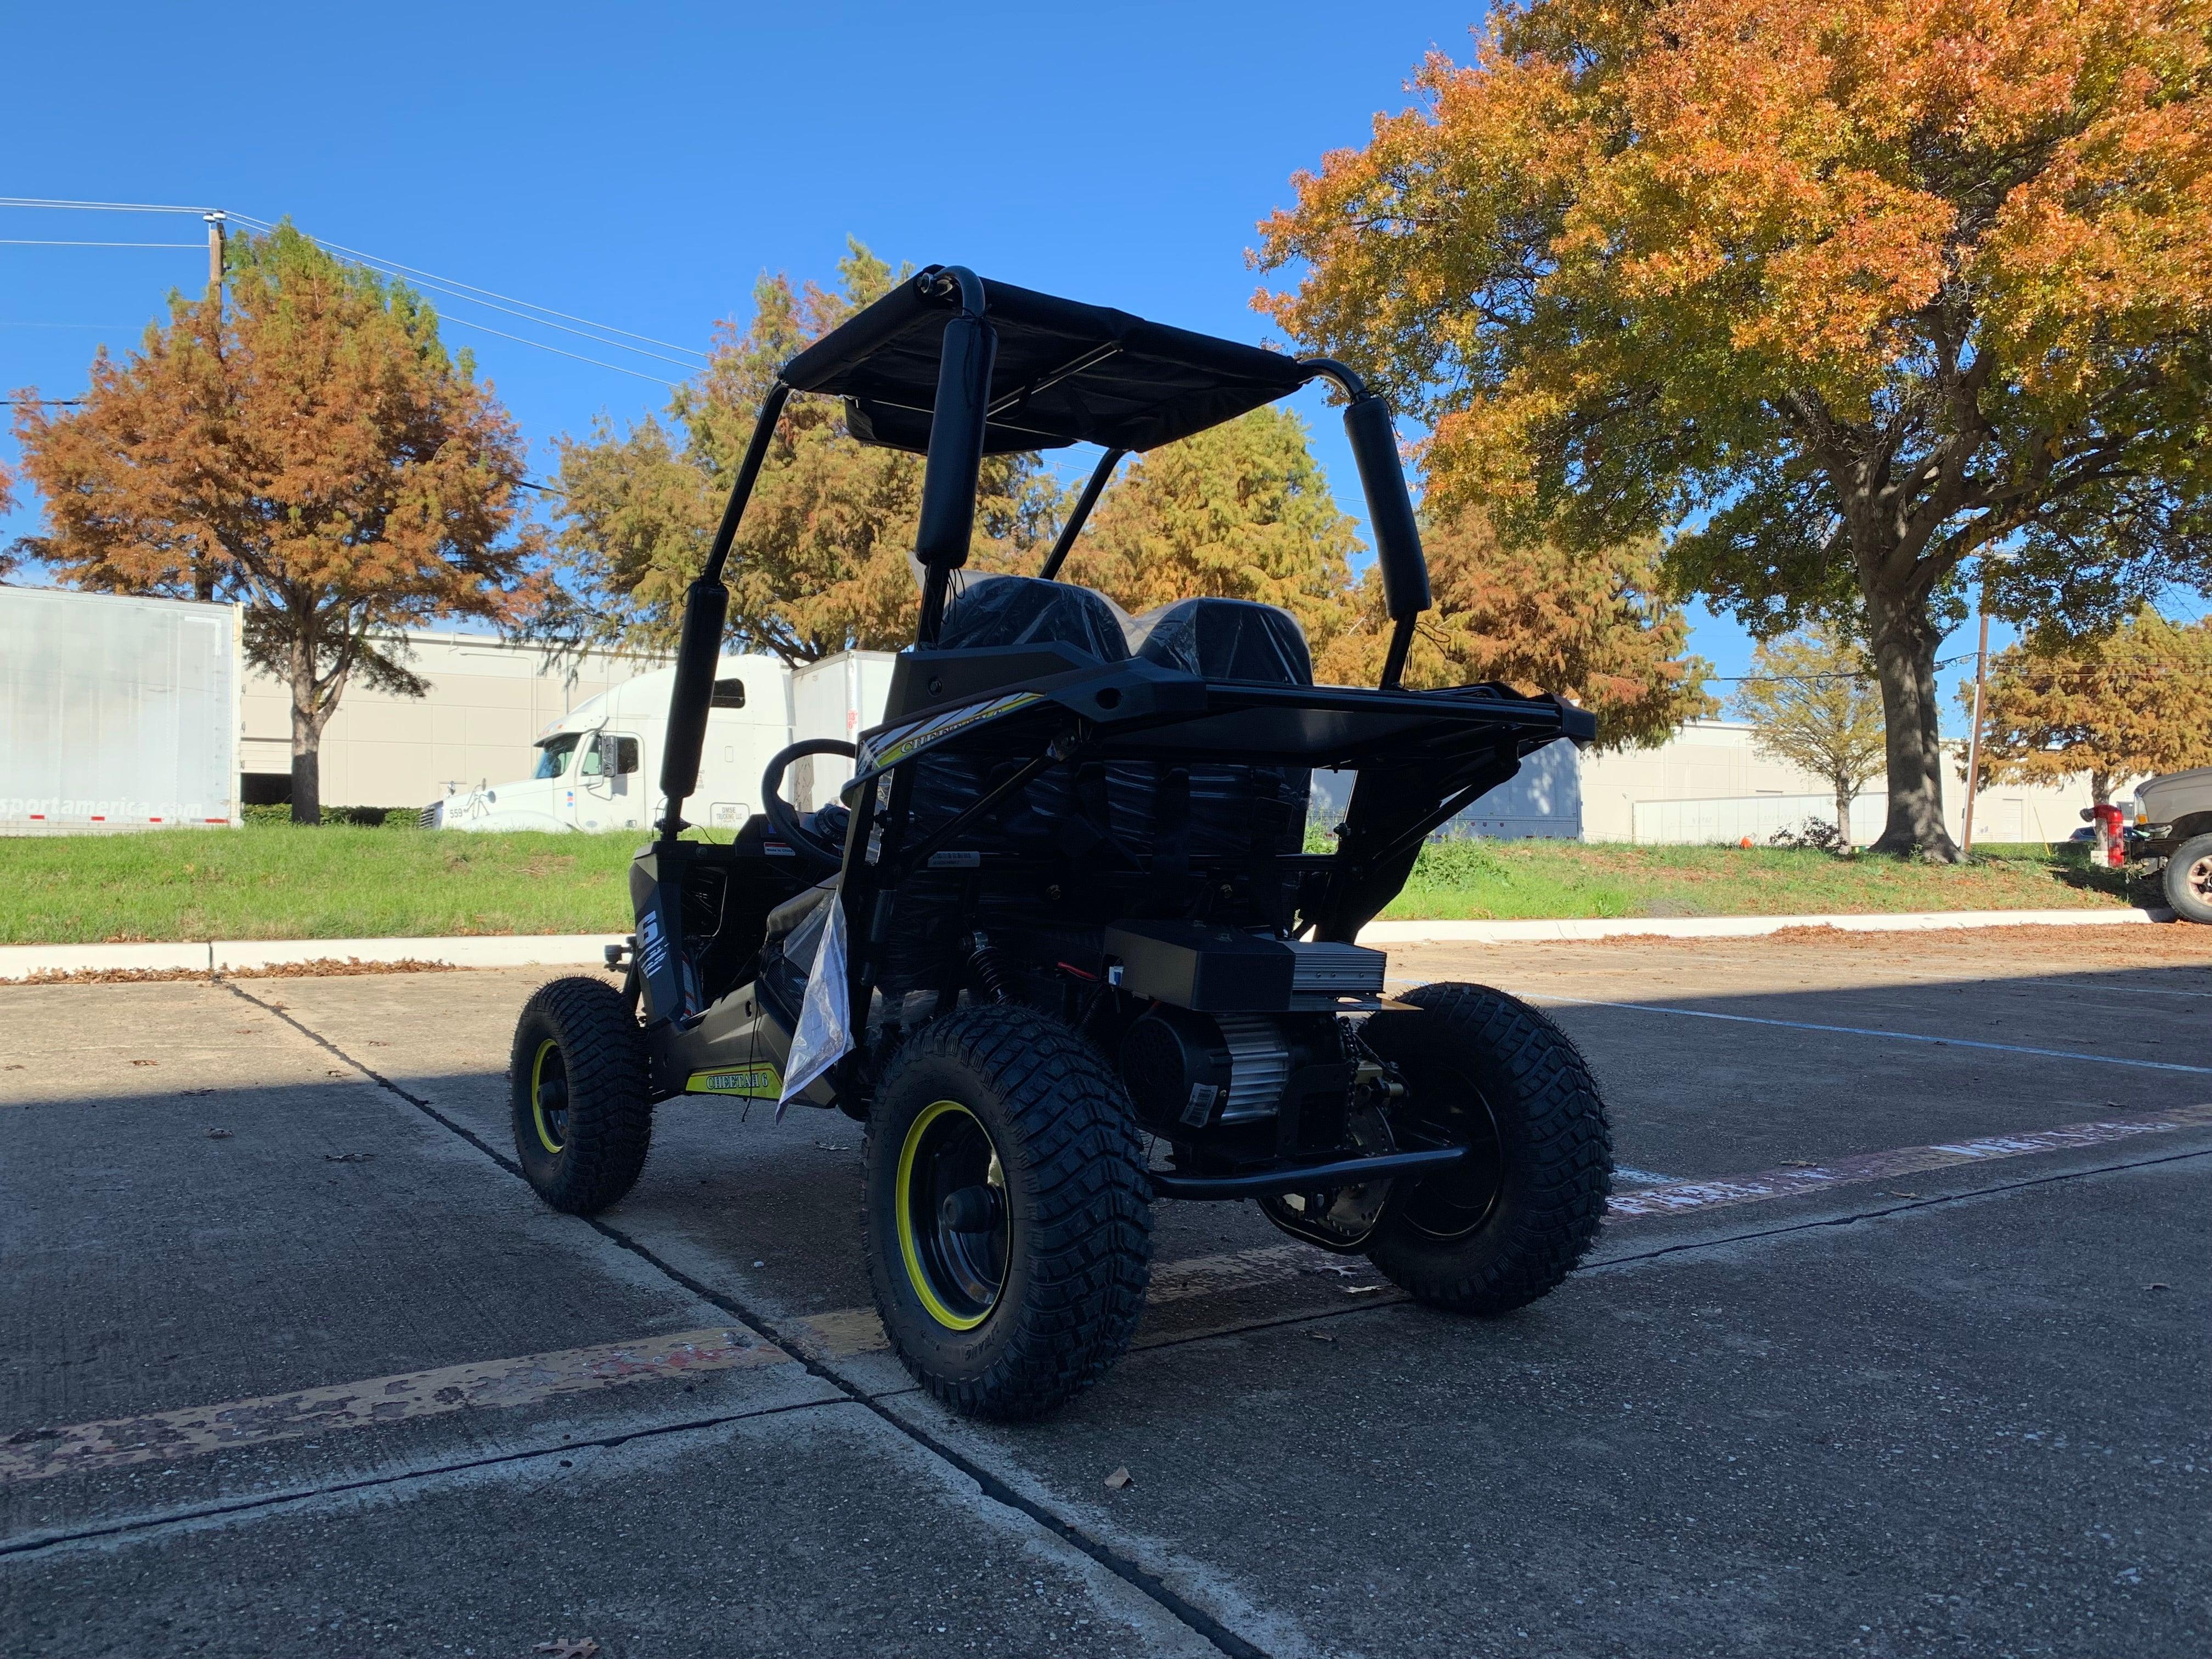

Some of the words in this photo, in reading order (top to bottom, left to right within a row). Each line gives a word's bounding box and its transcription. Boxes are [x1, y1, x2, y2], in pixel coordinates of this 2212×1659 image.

[450, 808, 462, 819] 559
[707, 1074, 760, 1090] CHEETAH
[761, 1073, 769, 1088] 6
